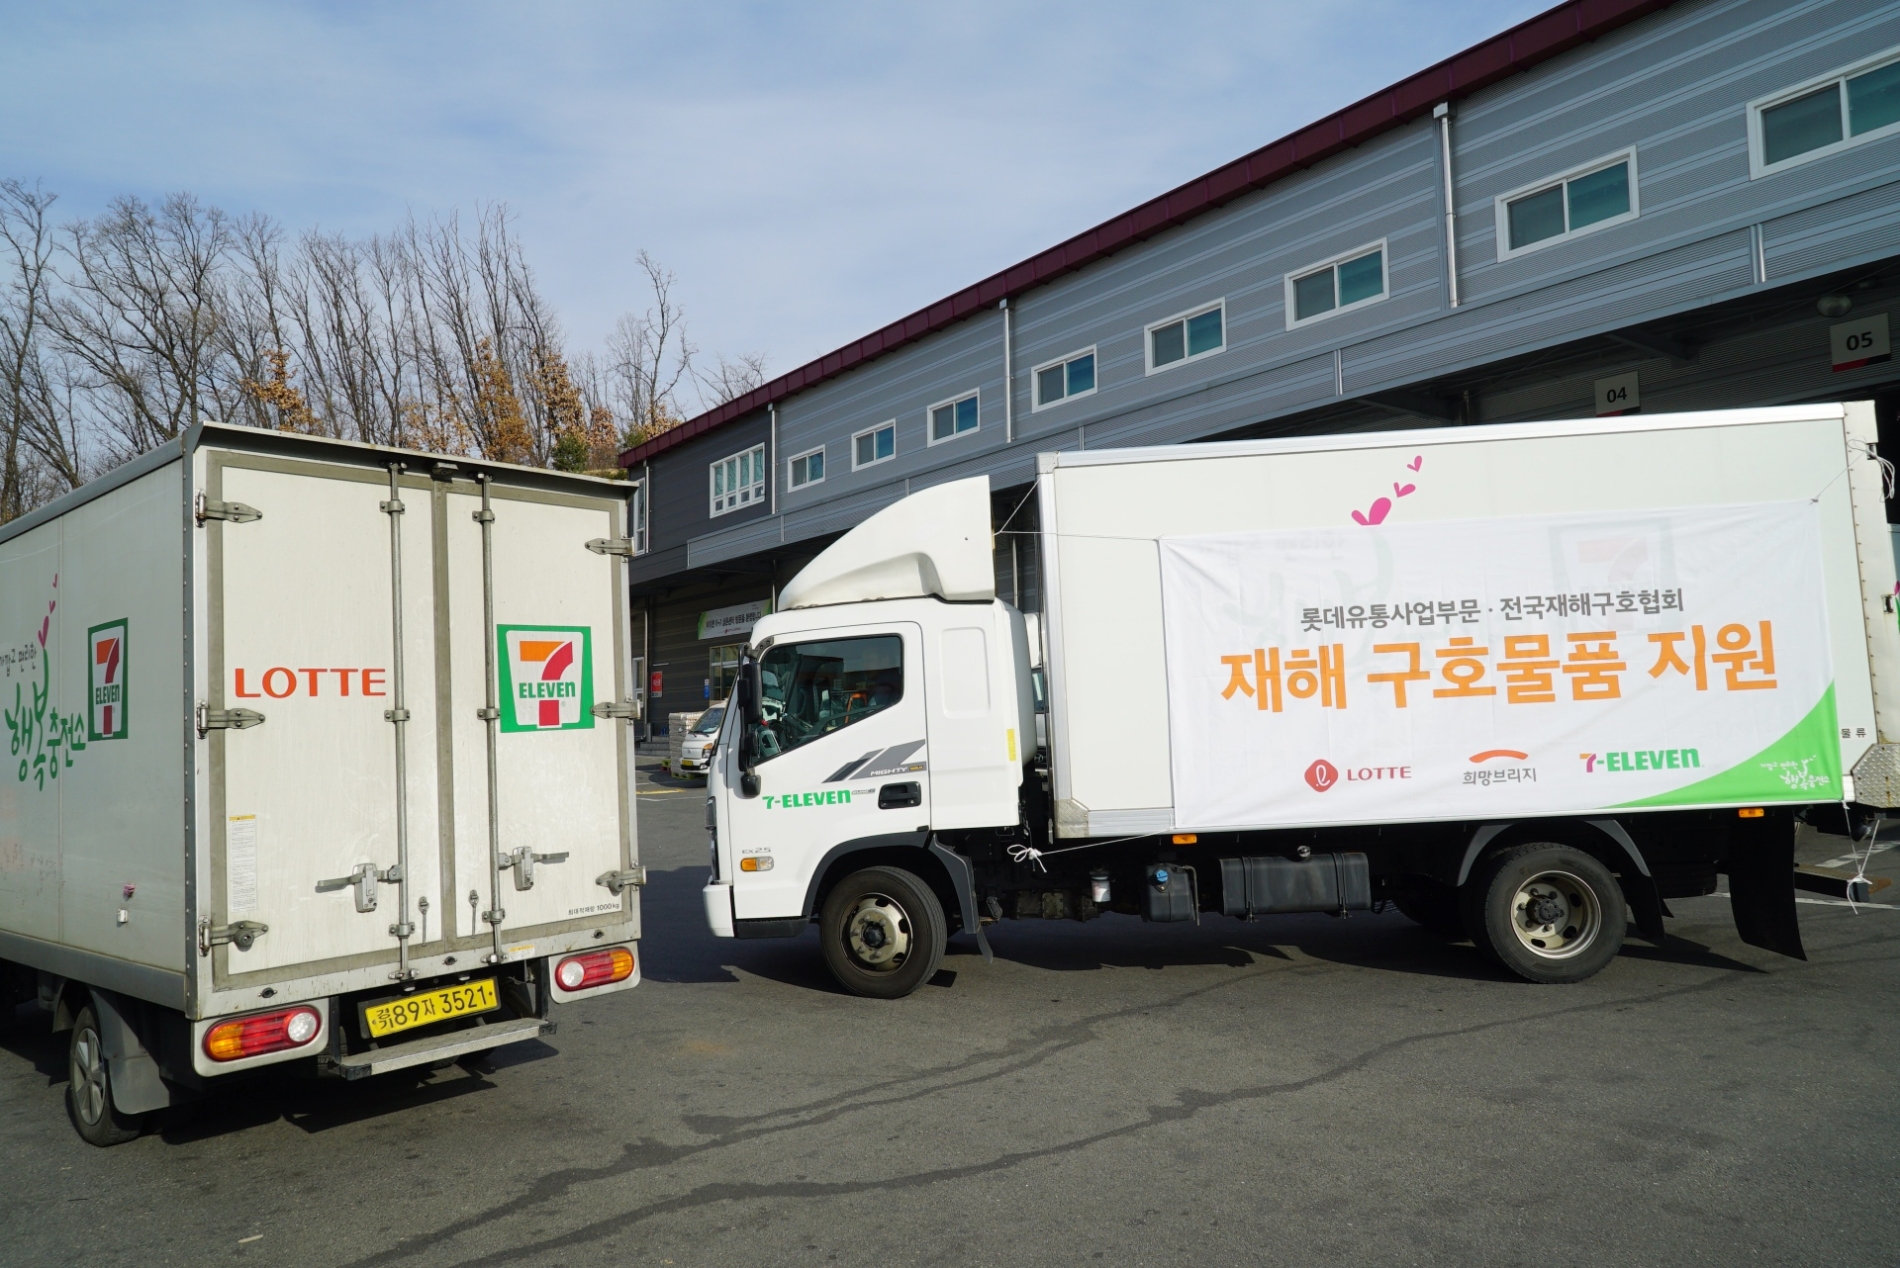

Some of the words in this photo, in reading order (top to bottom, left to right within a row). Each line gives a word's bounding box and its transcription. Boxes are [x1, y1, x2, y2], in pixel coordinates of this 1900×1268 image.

[1846, 331, 1874, 351] 05
[1606, 386, 1628, 403] 04
[1301, 599, 1481, 632] 롯데유통사업부문
[1500, 588, 1684, 621] 전국재해구호협회
[1221, 643, 1347, 713] 재해
[1367, 631, 1627, 708] 구호물품
[1647, 620, 1778, 691] 지원
[234, 667, 386, 699] LOTTE
[4, 649, 87, 792] 행복충전소
[870, 766, 907, 776] MIGHTY
[1347, 766, 1412, 781] LOTTE
[1463, 768, 1537, 787] 희망브리지
[596, 903, 620, 911] 1000kg
[439, 985, 487, 1014] 3521
